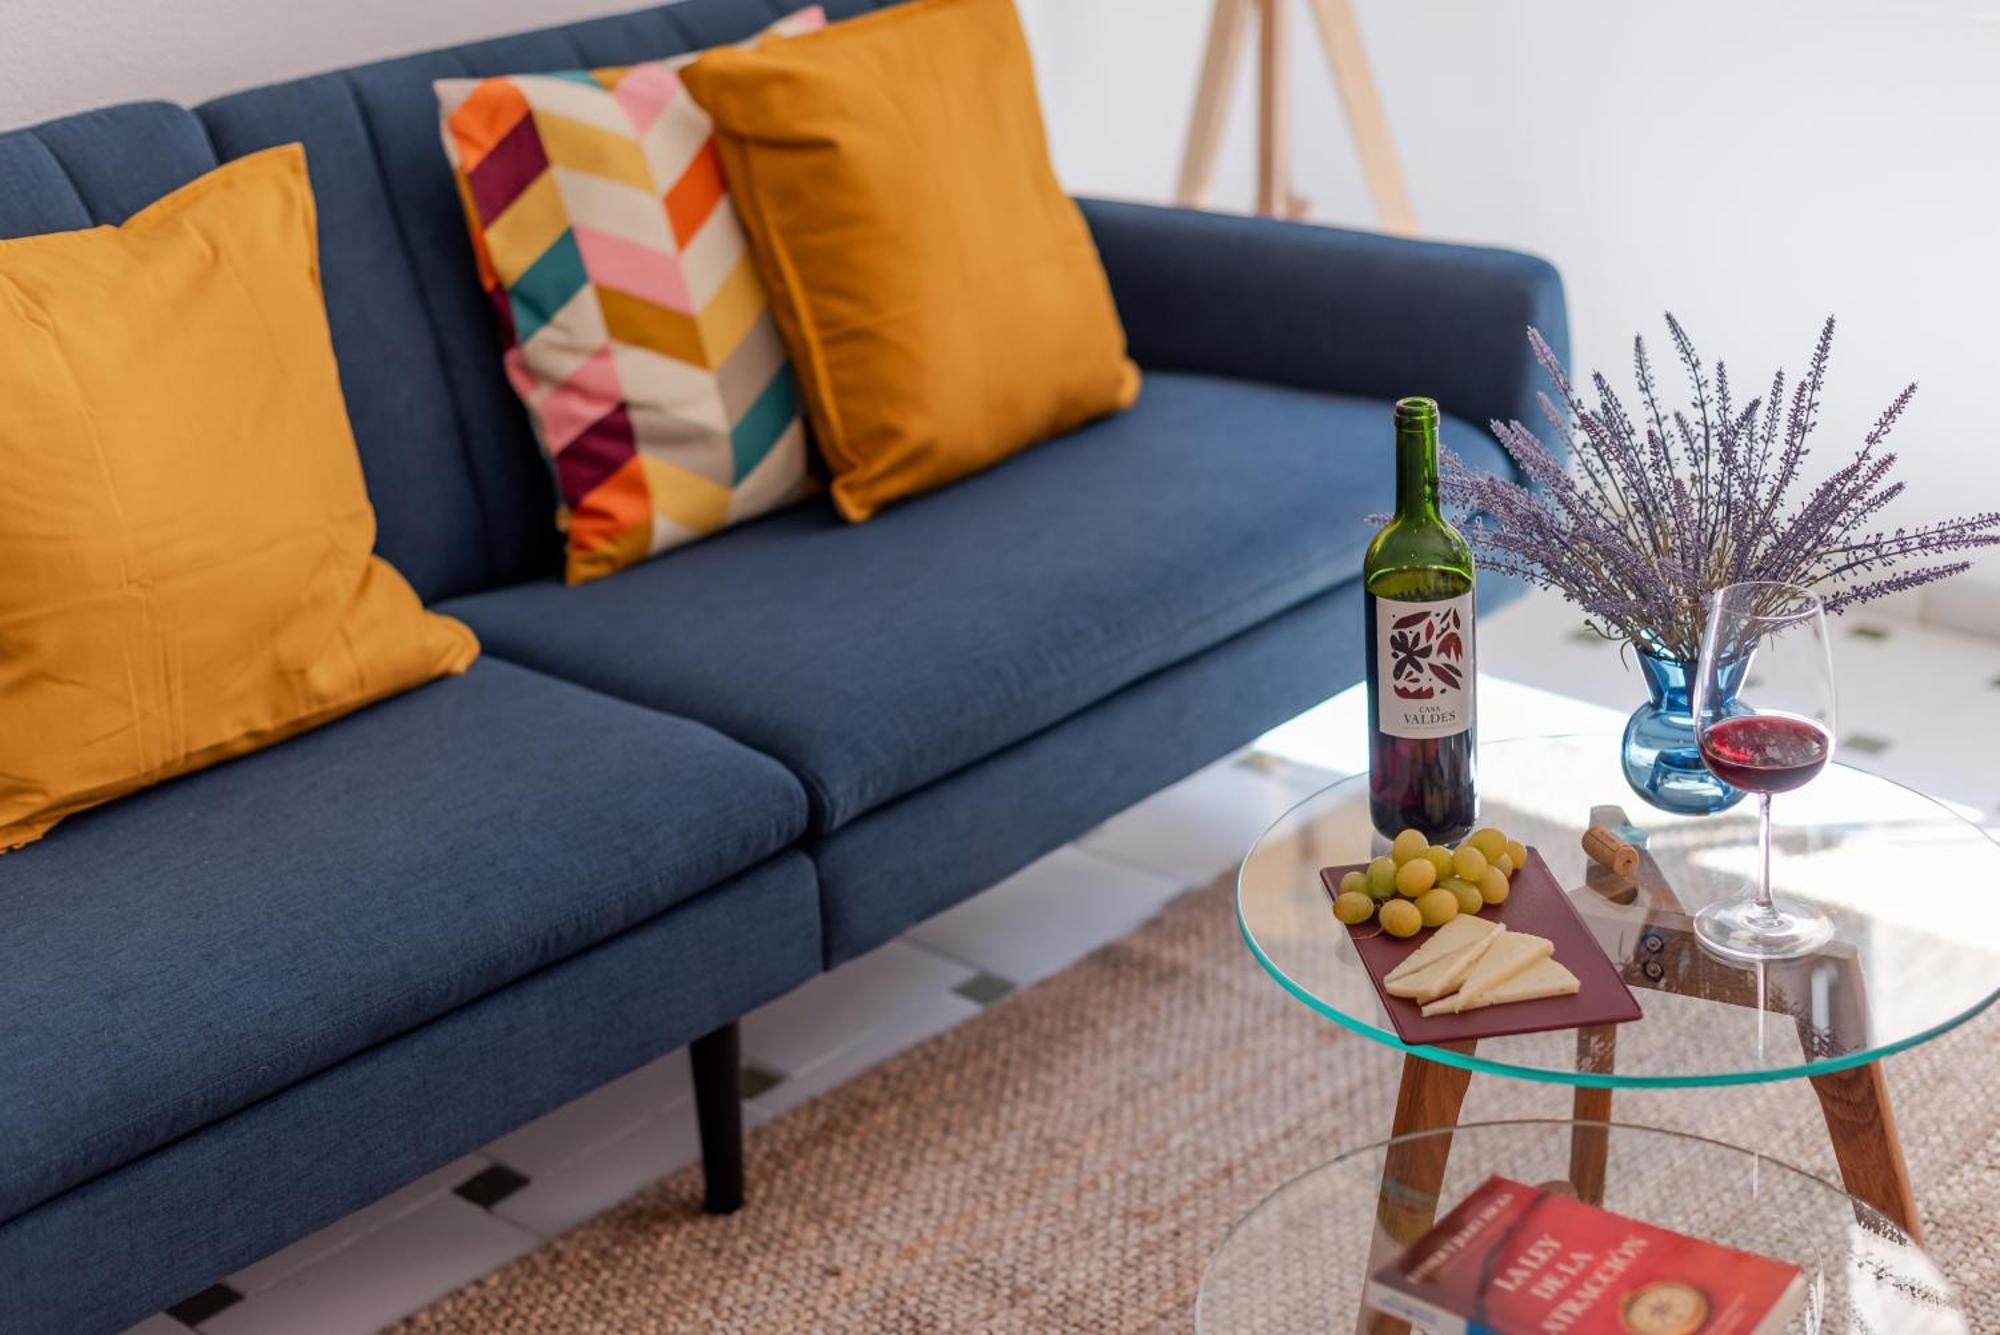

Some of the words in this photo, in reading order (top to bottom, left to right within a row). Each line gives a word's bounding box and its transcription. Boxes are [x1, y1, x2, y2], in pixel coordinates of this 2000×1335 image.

[1403, 710, 1456, 725] VALDES
[1418, 705, 1441, 713] CASA
[1492, 1266, 1532, 1292] LA
[1517, 1233, 1562, 1271] LEY
[1529, 1272, 1571, 1300] DE
[1556, 1251, 1594, 1277] LA
